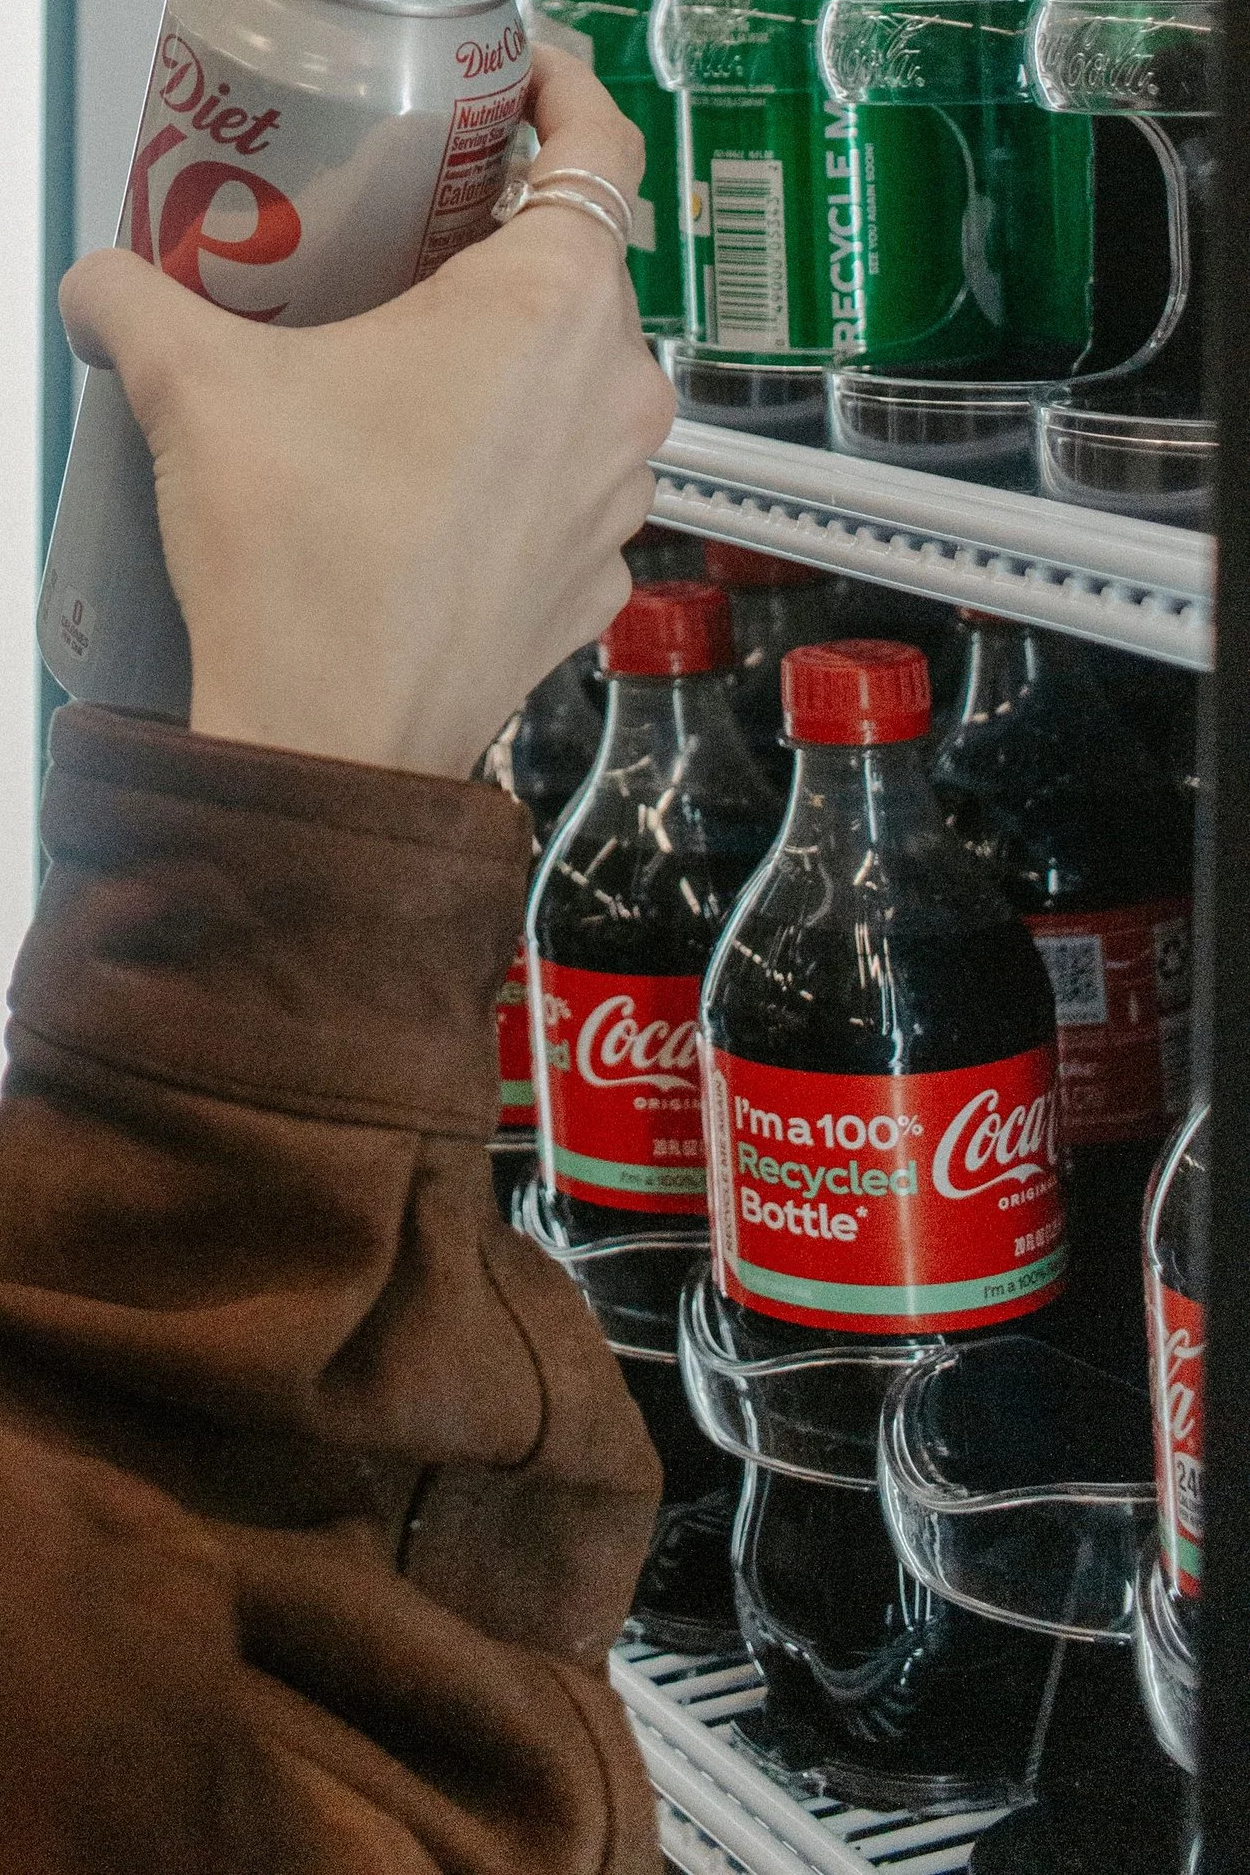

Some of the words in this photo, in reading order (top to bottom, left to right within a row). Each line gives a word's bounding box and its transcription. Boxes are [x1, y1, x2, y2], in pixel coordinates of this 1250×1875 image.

[455, 40, 505, 80] Diet
[504, 18, 526, 63] Co
[159, 33, 281, 155] Diet
[456, 96, 518, 131] Nutrition
[822, 99, 858, 139] M
[437, 179, 494, 208] Calori
[827, 150, 865, 355] RECYCLE
[734, 1095, 784, 1141] I'm
[786, 1118, 815, 1147] a
[816, 1113, 924, 1151] 100%
[737, 1141, 918, 1199] Recycled
